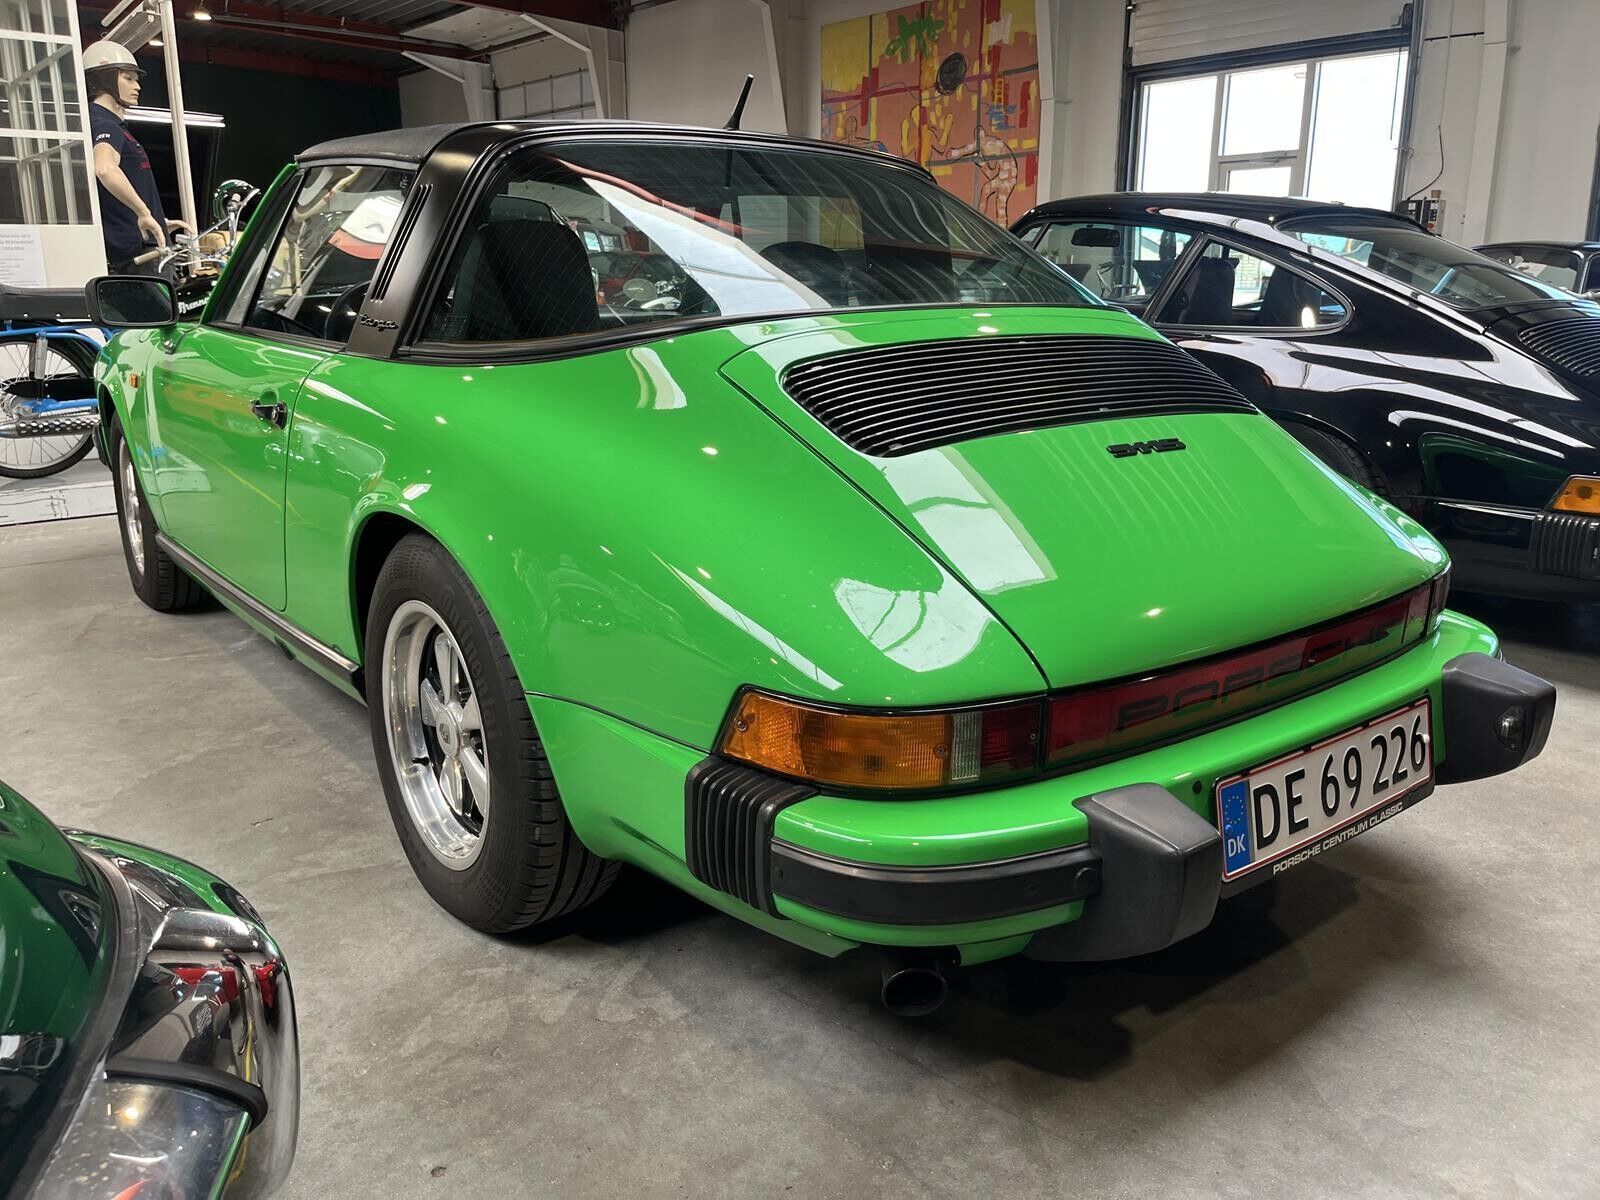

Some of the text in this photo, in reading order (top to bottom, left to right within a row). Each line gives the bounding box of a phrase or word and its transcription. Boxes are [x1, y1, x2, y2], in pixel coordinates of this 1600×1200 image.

[1253, 713, 1427, 850] DE 69 226
[1227, 833, 1246, 858] DK
[1273, 802, 1404, 875] PORSCHE CENTRUM CLASSIC
